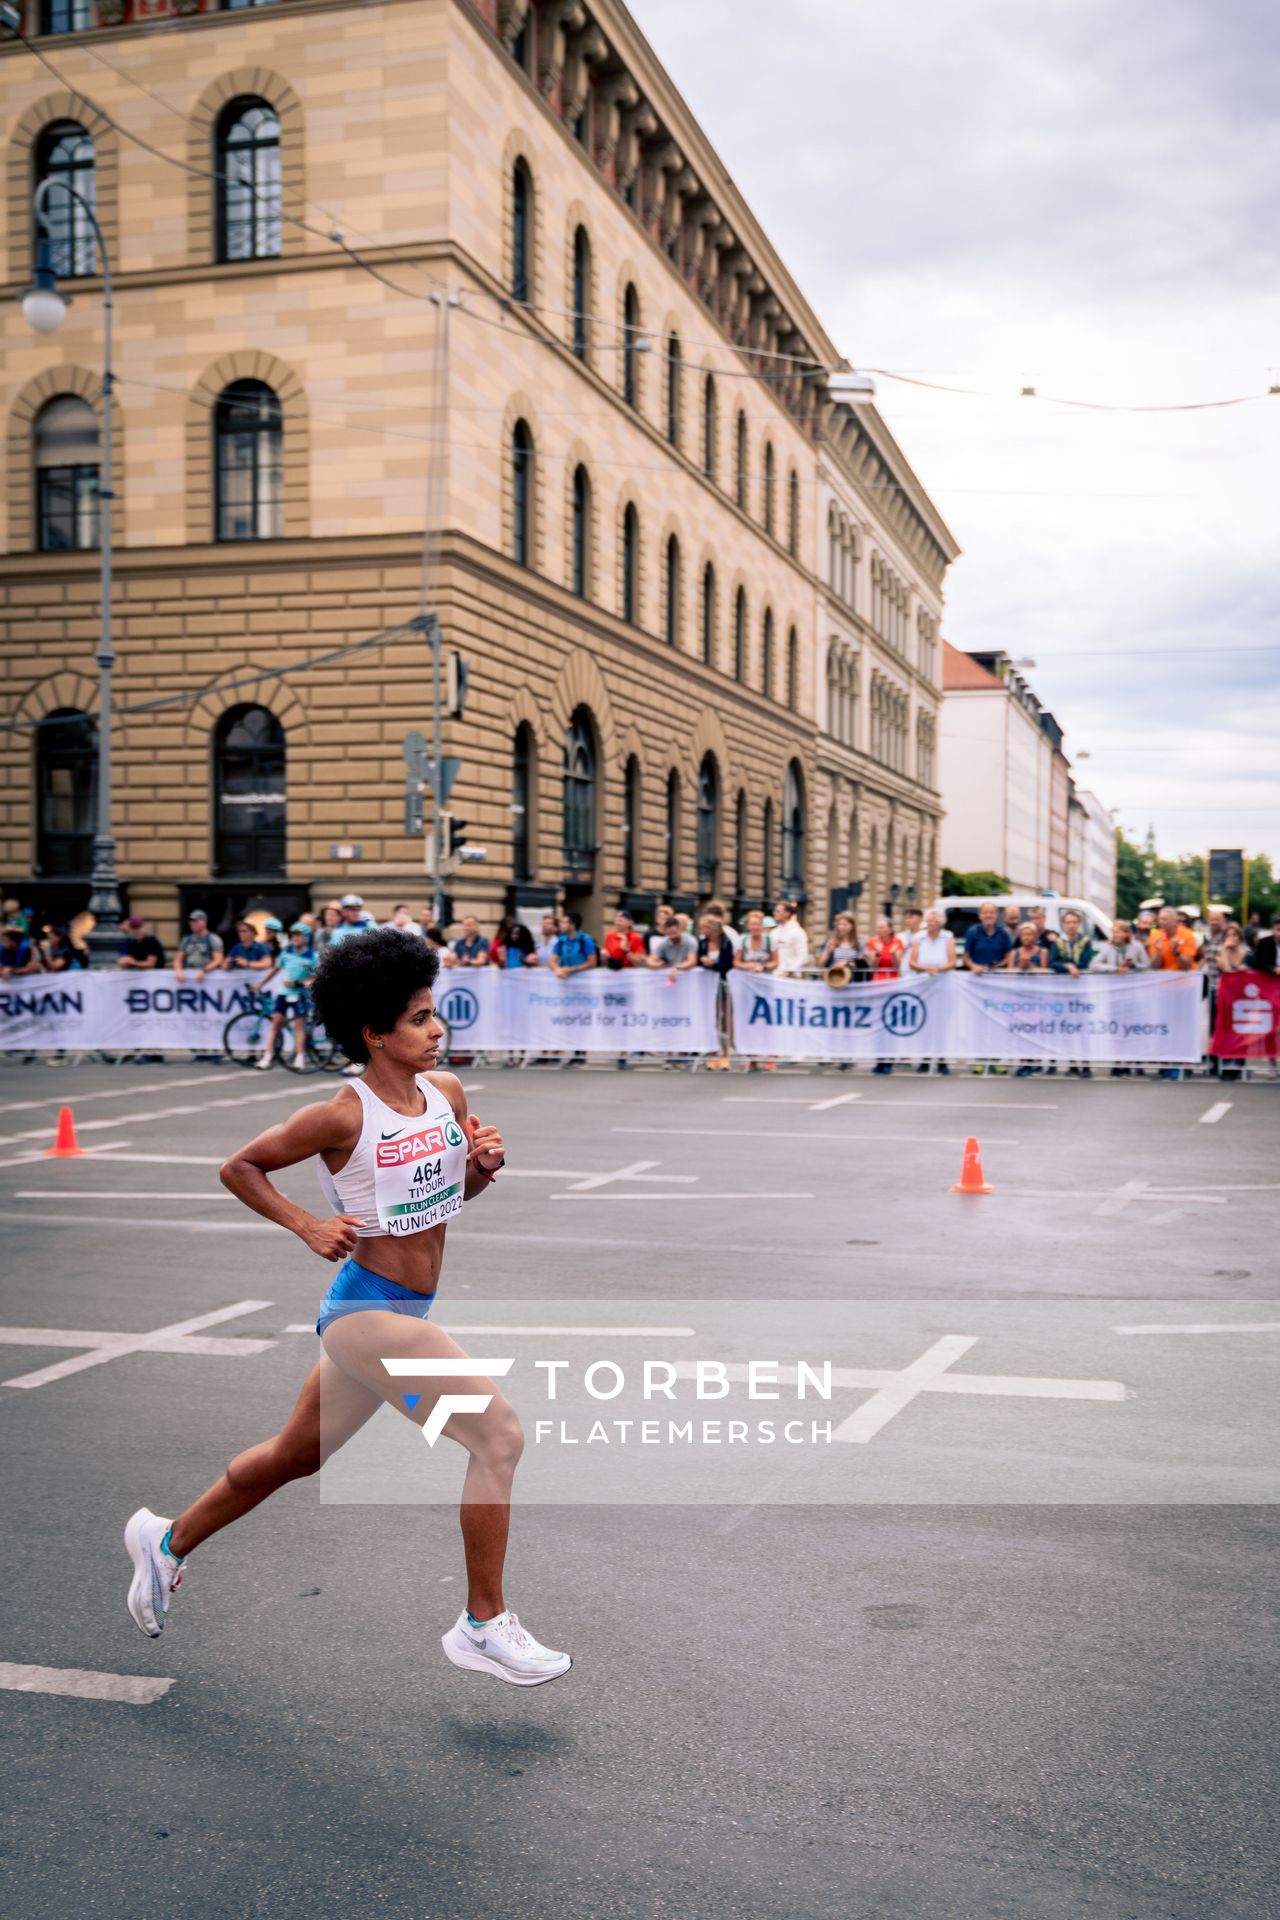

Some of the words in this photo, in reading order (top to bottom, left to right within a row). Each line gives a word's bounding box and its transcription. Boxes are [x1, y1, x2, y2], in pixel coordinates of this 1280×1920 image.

[603, 993, 628, 1006] the
[983, 998, 1064, 1016] Preparing
[1068, 1000, 1096, 1013] the
[551, 1013, 592, 1026] world
[596, 1013, 616, 1026] for
[620, 1013, 648, 1027] 130
[652, 1016, 692, 1029] years
[749, 996, 872, 1029] Allianz
[1008, 1021, 1055, 1034] world
[1059, 1020, 1083, 1034] for
[1089, 1022, 1118, 1034] 130
[1122, 1022, 1169, 1037] years
[378, 1129, 445, 1165] SPAR
[413, 1158, 442, 1185] 464
[408, 1175, 446, 1199] TIYOURI
[409, 1199, 429, 1212] RUN
[428, 1190, 449, 1206] CLEAN
[387, 1208, 438, 1234] MUNICH
[440, 1195, 463, 1218] 2022
